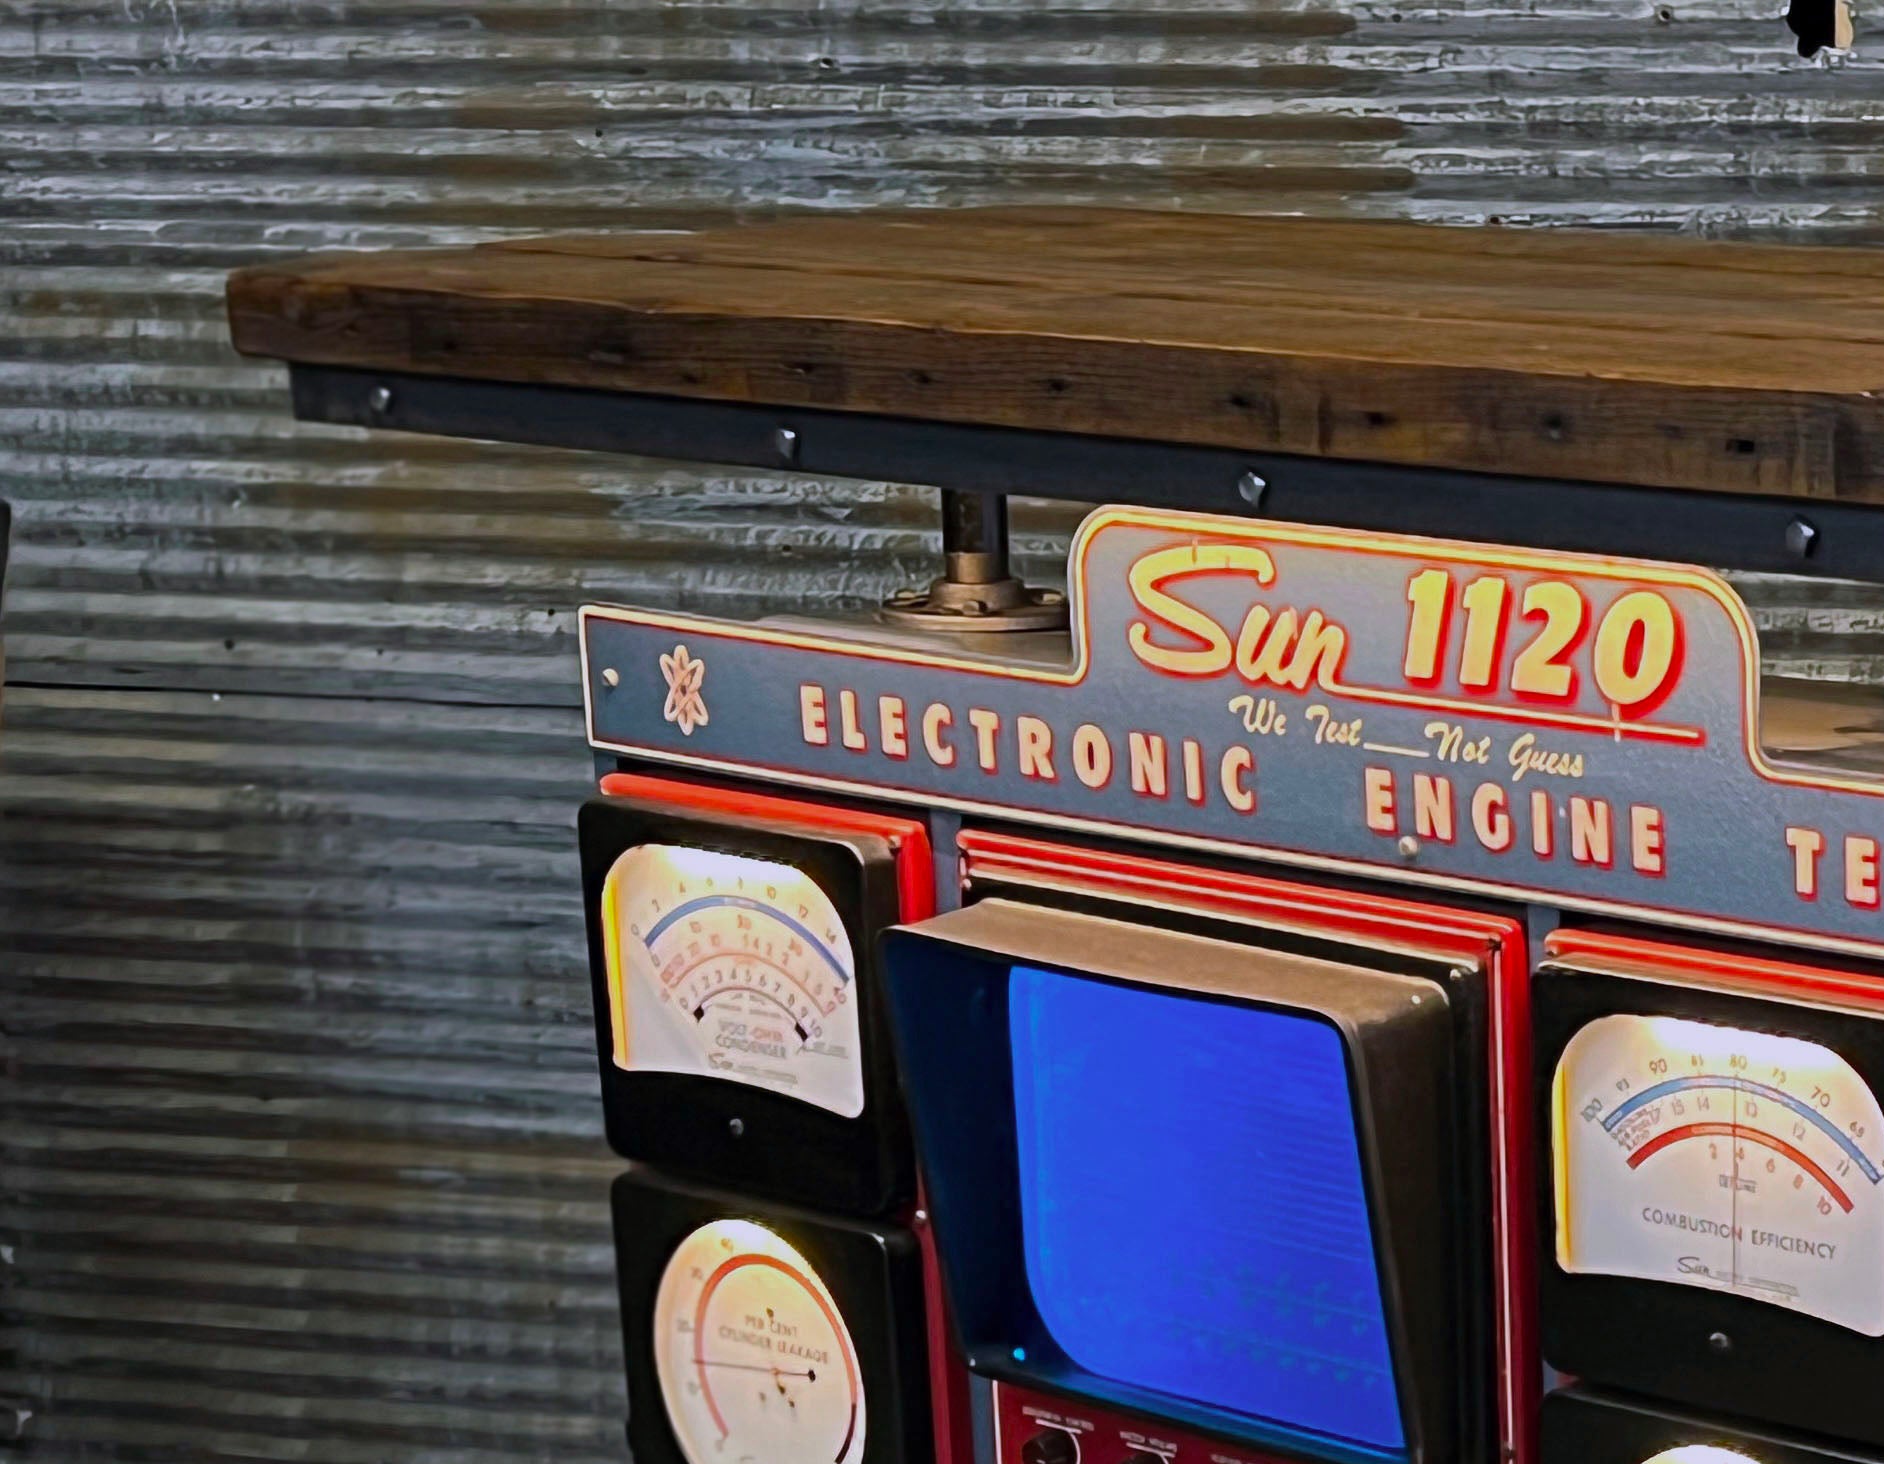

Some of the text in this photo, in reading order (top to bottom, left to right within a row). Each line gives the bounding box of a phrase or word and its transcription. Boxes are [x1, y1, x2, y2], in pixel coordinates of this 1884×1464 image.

[1127, 541, 1684, 719] Sun 1120
[799, 684, 1255, 812] ELECTRONIC
[1364, 766, 1666, 874] ENGINE
[1228, 694, 1585, 782] We Test Not Guess
[1648, 1057, 1668, 1075] 90
[1810, 1085, 1832, 1109] 70
[1642, 1206, 1837, 1260] COMBUSTION EFFICIENCY
